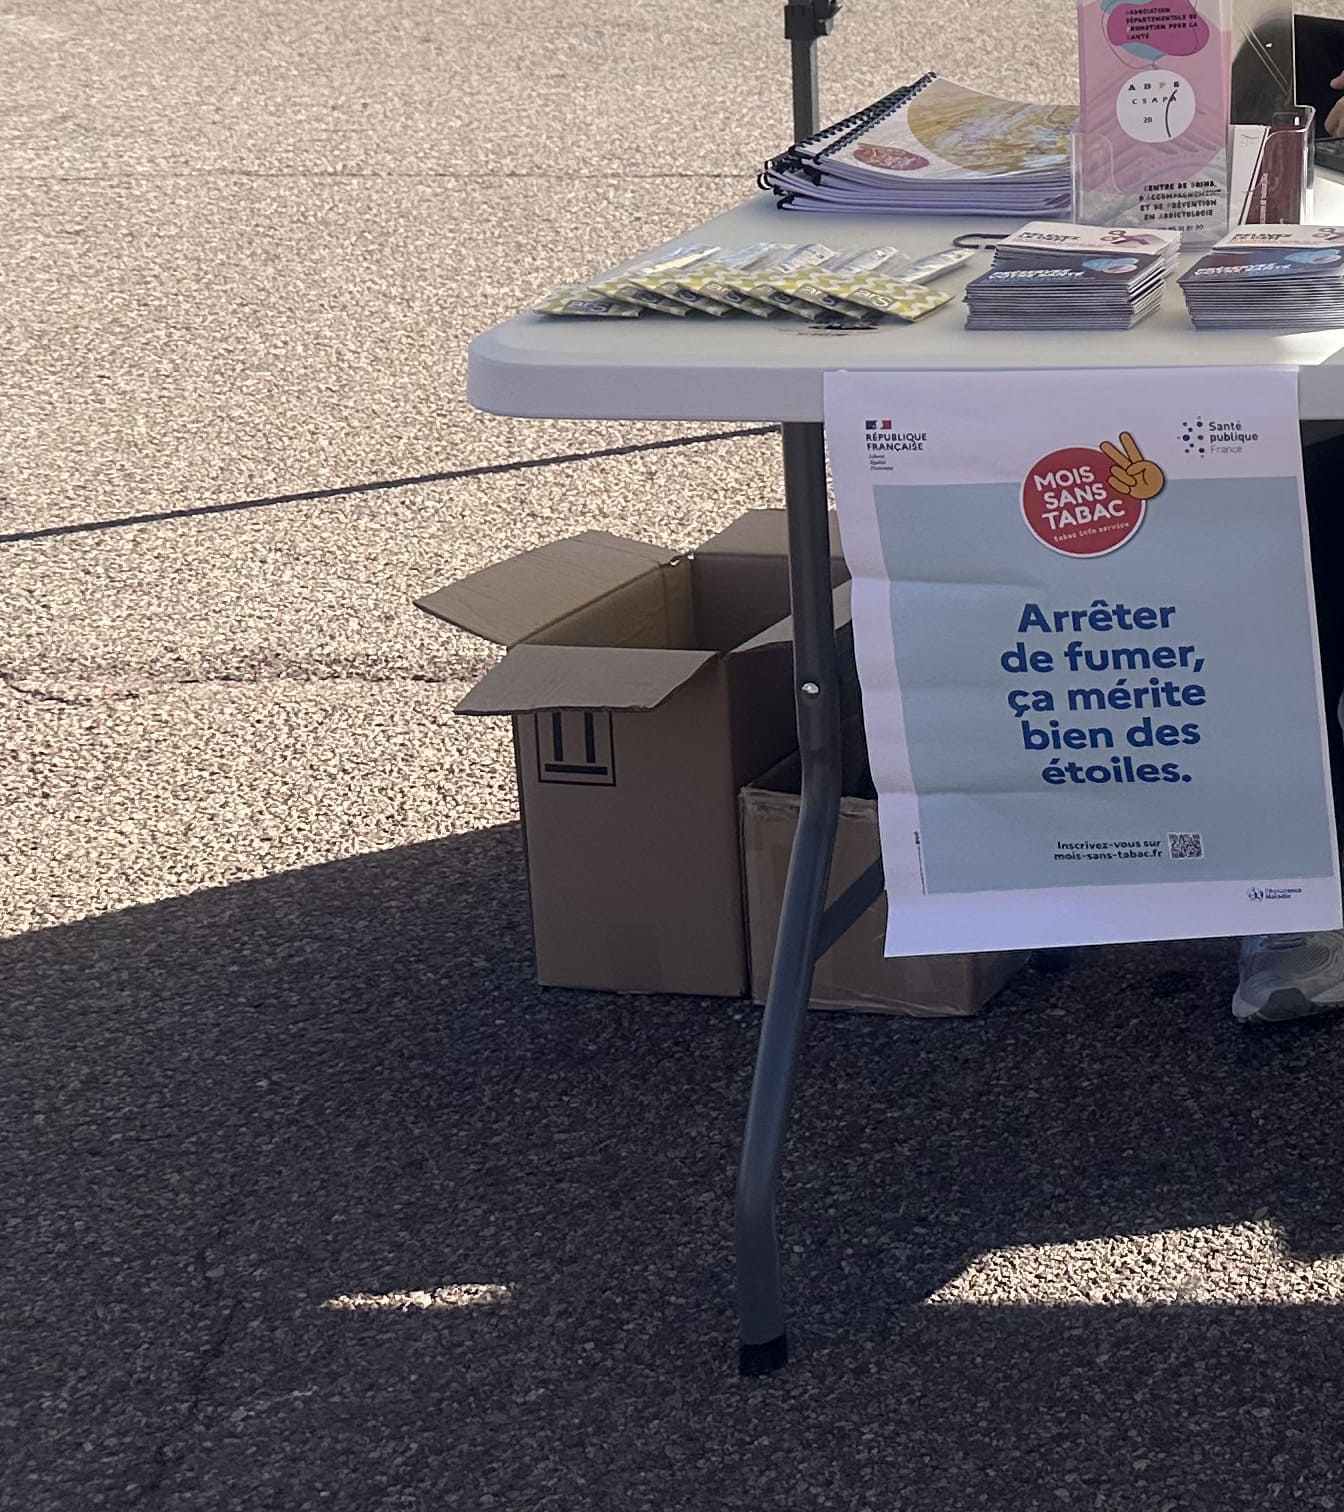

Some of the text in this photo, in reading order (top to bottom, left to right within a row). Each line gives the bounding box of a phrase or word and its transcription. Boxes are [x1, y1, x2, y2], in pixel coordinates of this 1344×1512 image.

[866, 432, 928, 443] RÉPUBLIQUE
[1208, 420, 1242, 431] Santé
[1210, 431, 1258, 443] publique
[866, 442, 924, 452] FRANÇAISE
[1210, 444, 1243, 454] France
[1033, 465, 1096, 492] MOIS
[1043, 483, 1108, 510] SANS
[1041, 499, 1126, 530] TABAC
[1017, 599, 1177, 634] Arrêter
[1000, 641, 1206, 674] de fumer,
[1007, 678, 1207, 718] ça mérite
[1021, 717, 1201, 750] bien des
[1041, 756, 1193, 785] étoiles.
[1054, 849, 1163, 861] mois-sans-tabac.fr
[1057, 840, 1162, 850] Inscrivez-vous sur
